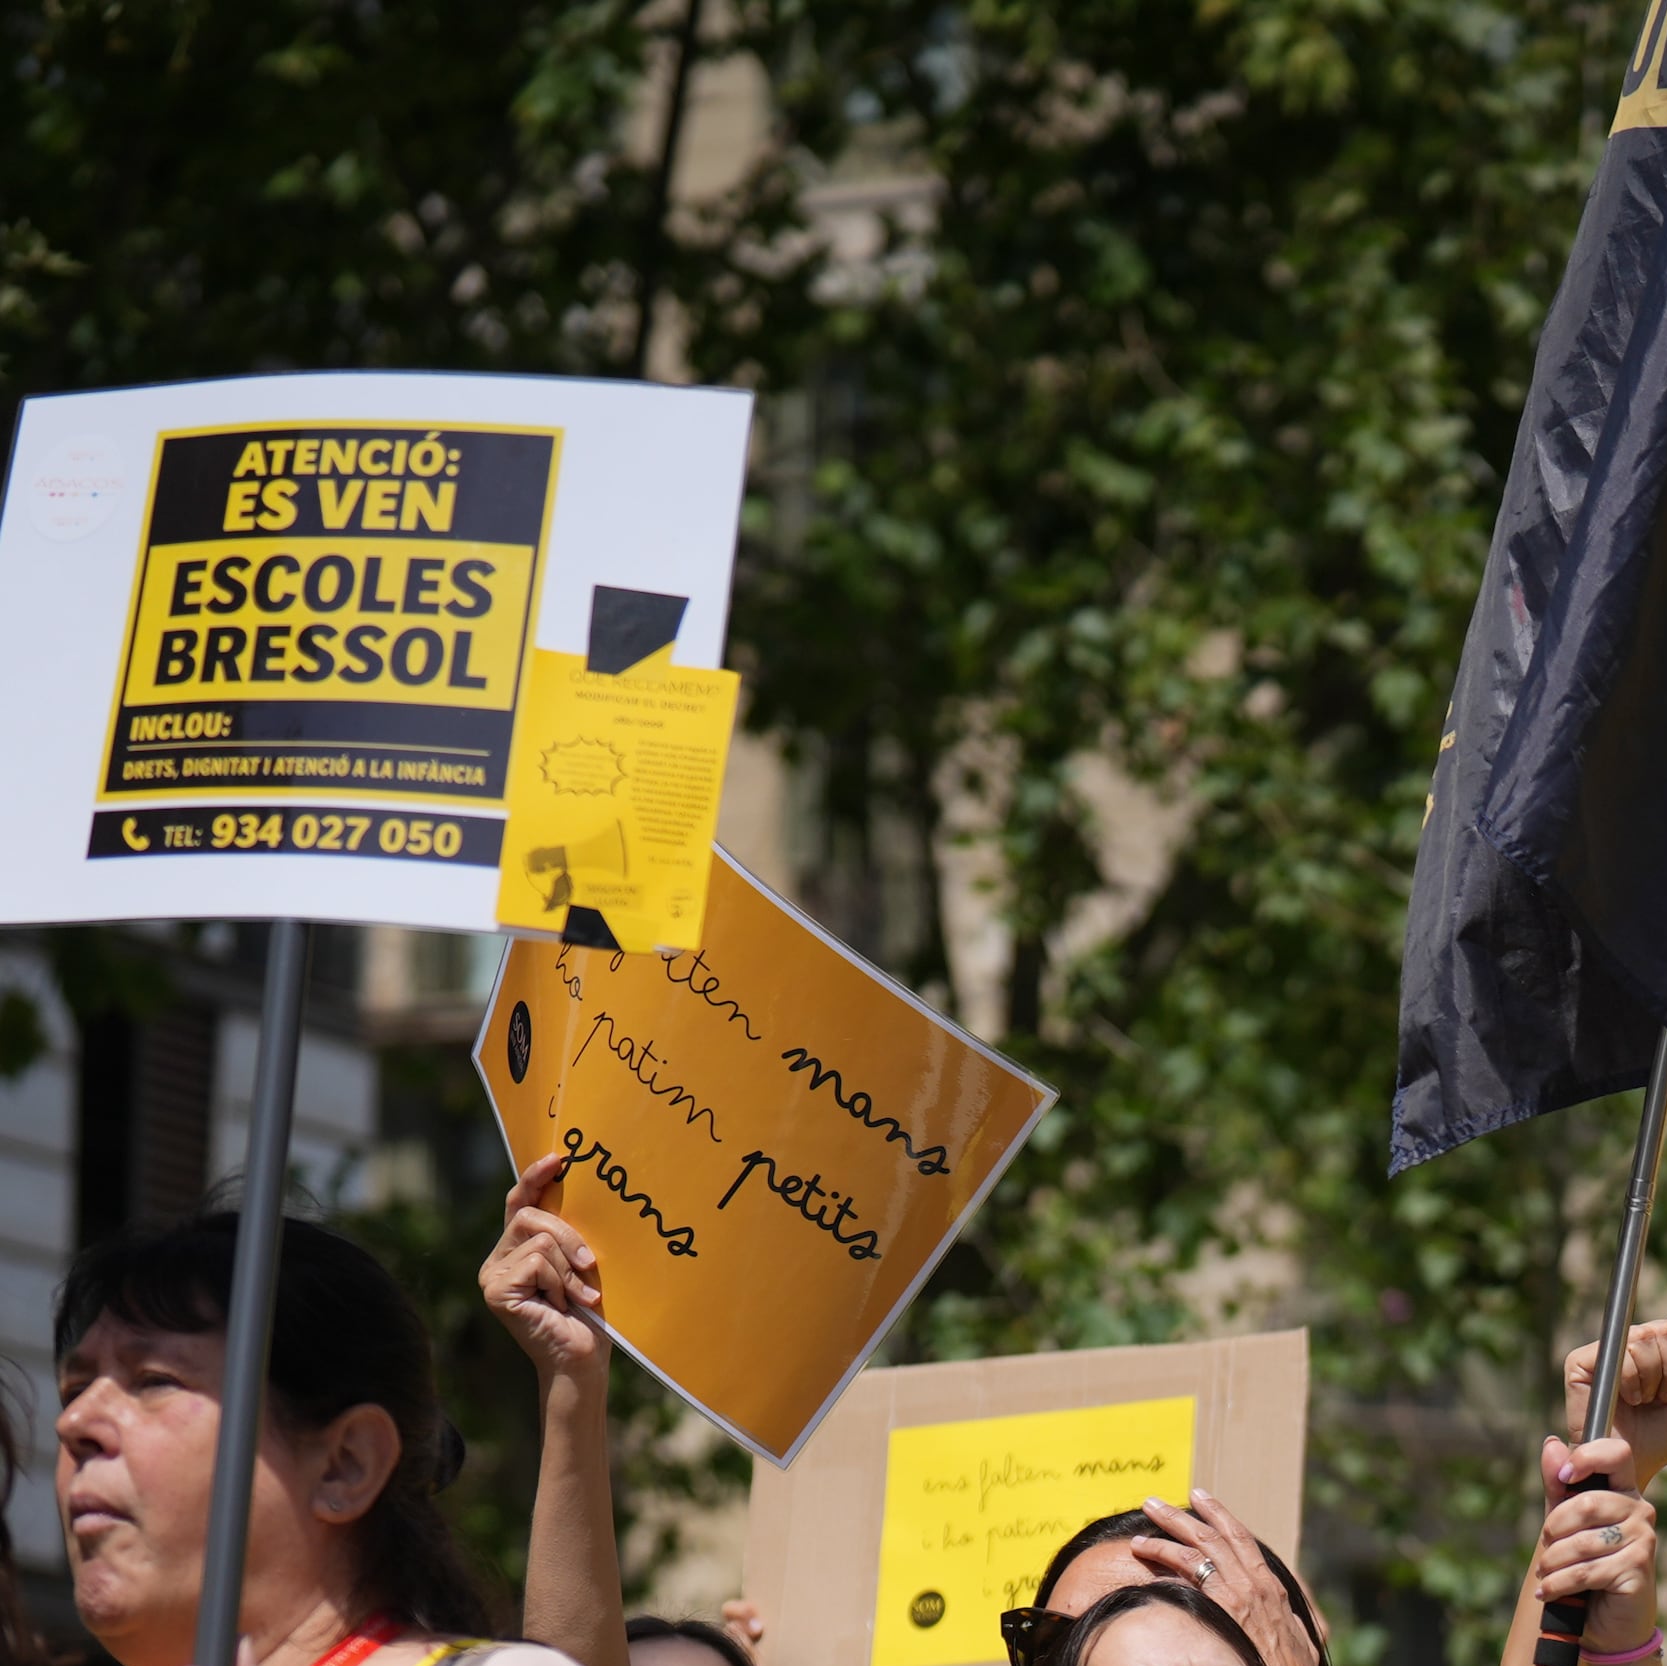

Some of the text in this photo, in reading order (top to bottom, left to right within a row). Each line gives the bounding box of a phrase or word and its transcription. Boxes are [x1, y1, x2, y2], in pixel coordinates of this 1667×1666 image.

[233, 431, 462, 478] ATENCIÓ:
[223, 480, 457, 533] ES VEN
[168, 555, 497, 618] ESCOLES
[153, 625, 488, 690] BRESSOL
[130, 711, 232, 742] INCLOU:
[122, 752, 486, 786] DRETS, DIGNITAT I ATENCIÓ A LA INFÀNCIA
[163, 814, 462, 858] TEL: 934 027 050
[572, 1011, 723, 1143] patim
[717, 1150, 883, 1260] petits
[782, 1047, 951, 1176] mans
[553, 1127, 699, 1258] grans
[1074, 1454, 1167, 1481] mans
